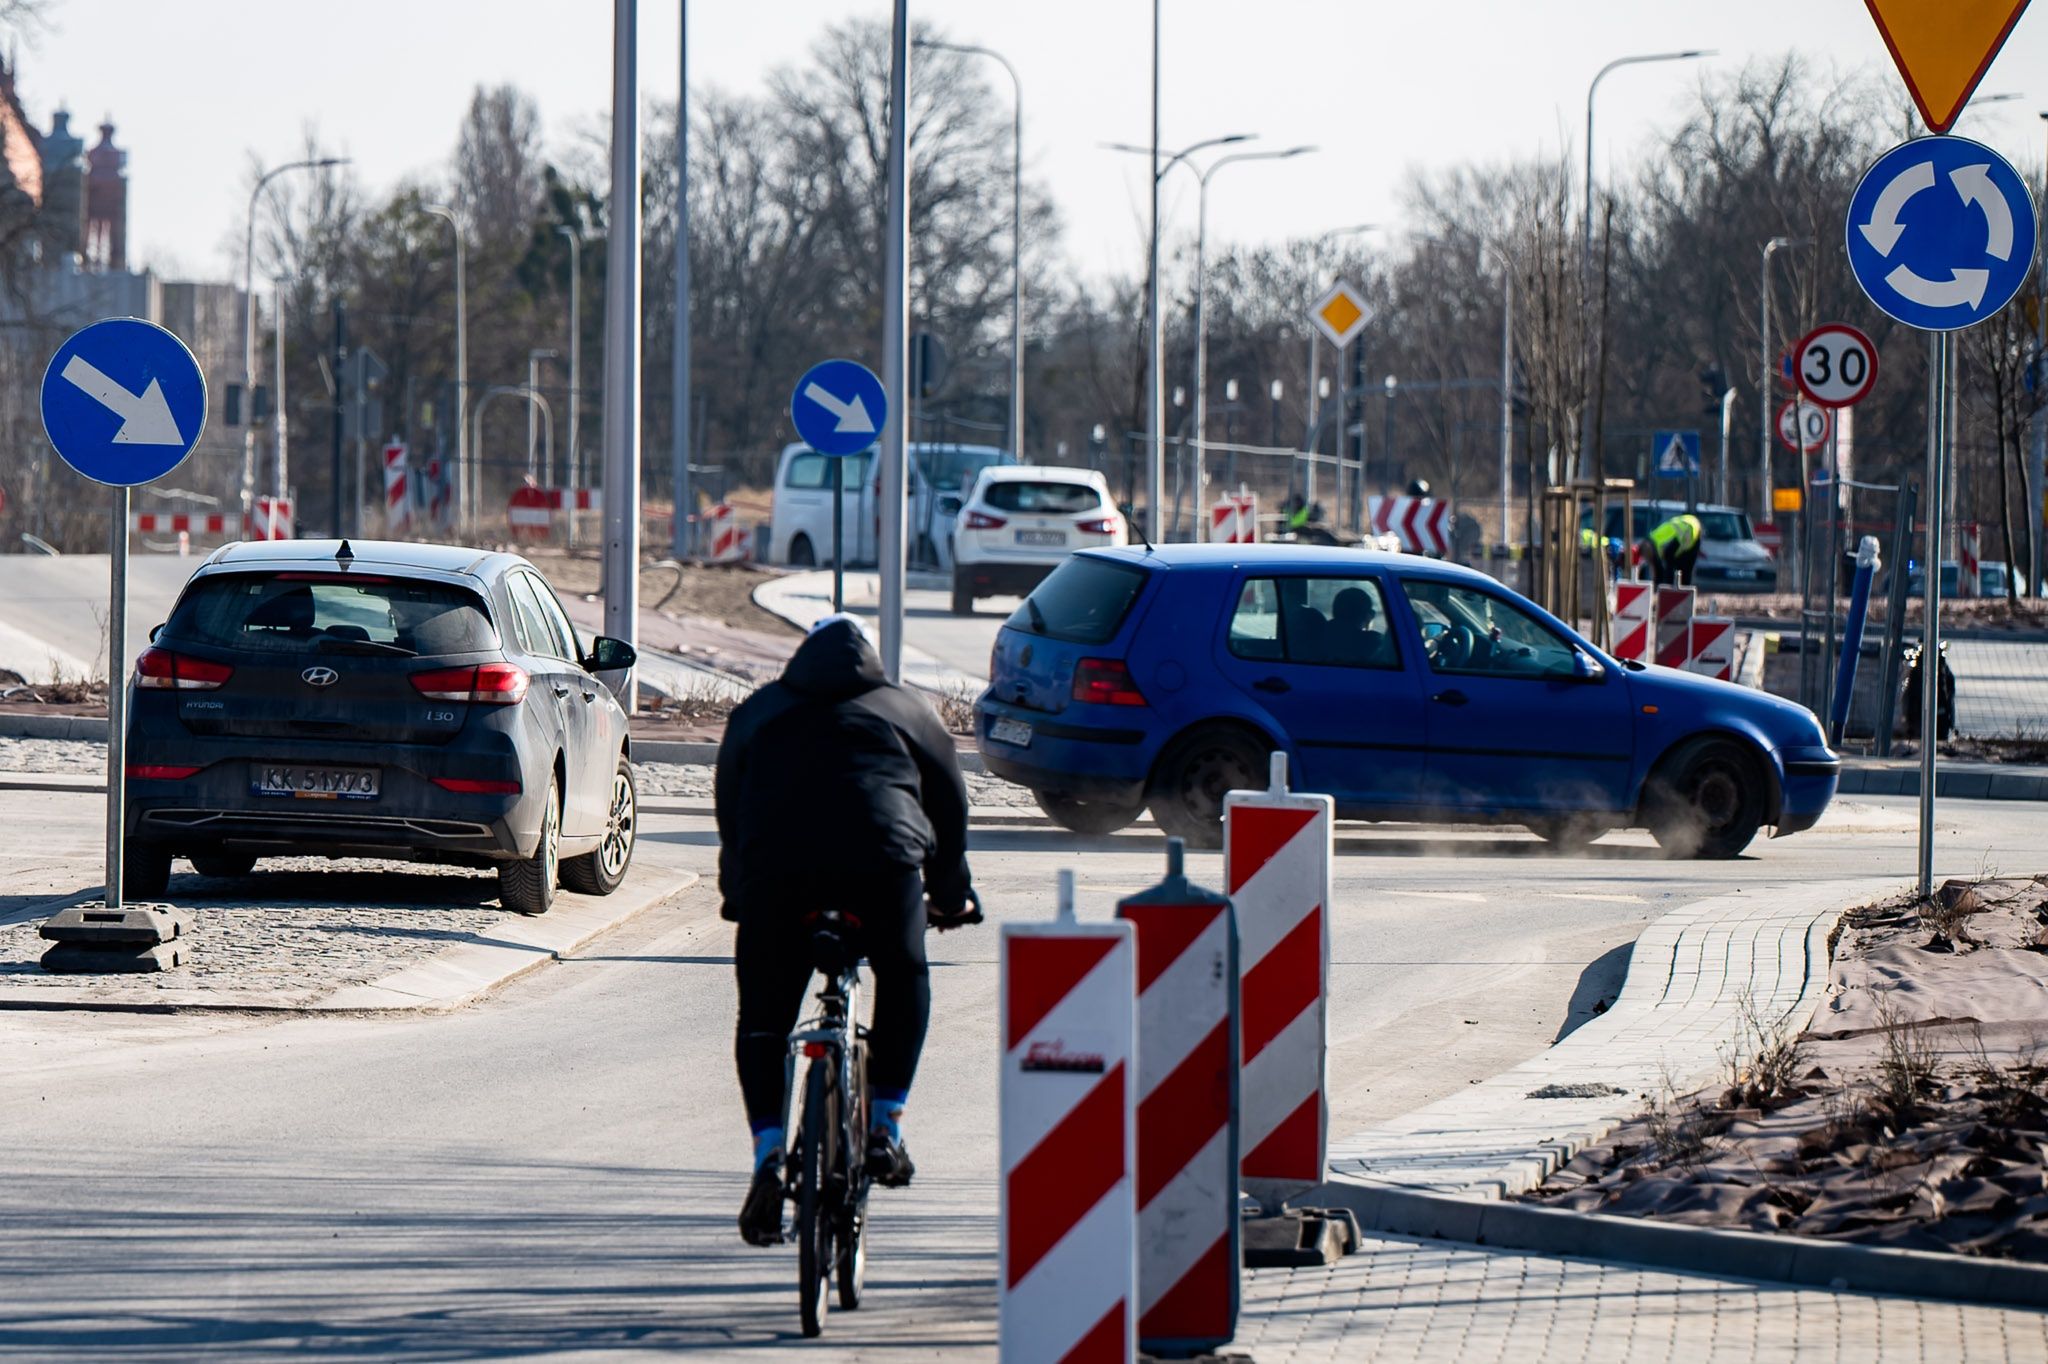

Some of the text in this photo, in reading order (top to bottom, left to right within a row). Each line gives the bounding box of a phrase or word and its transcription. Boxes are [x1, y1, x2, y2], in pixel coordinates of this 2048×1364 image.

[1805, 345, 1866, 387] 30
[267, 768, 373, 793] KK 51773
